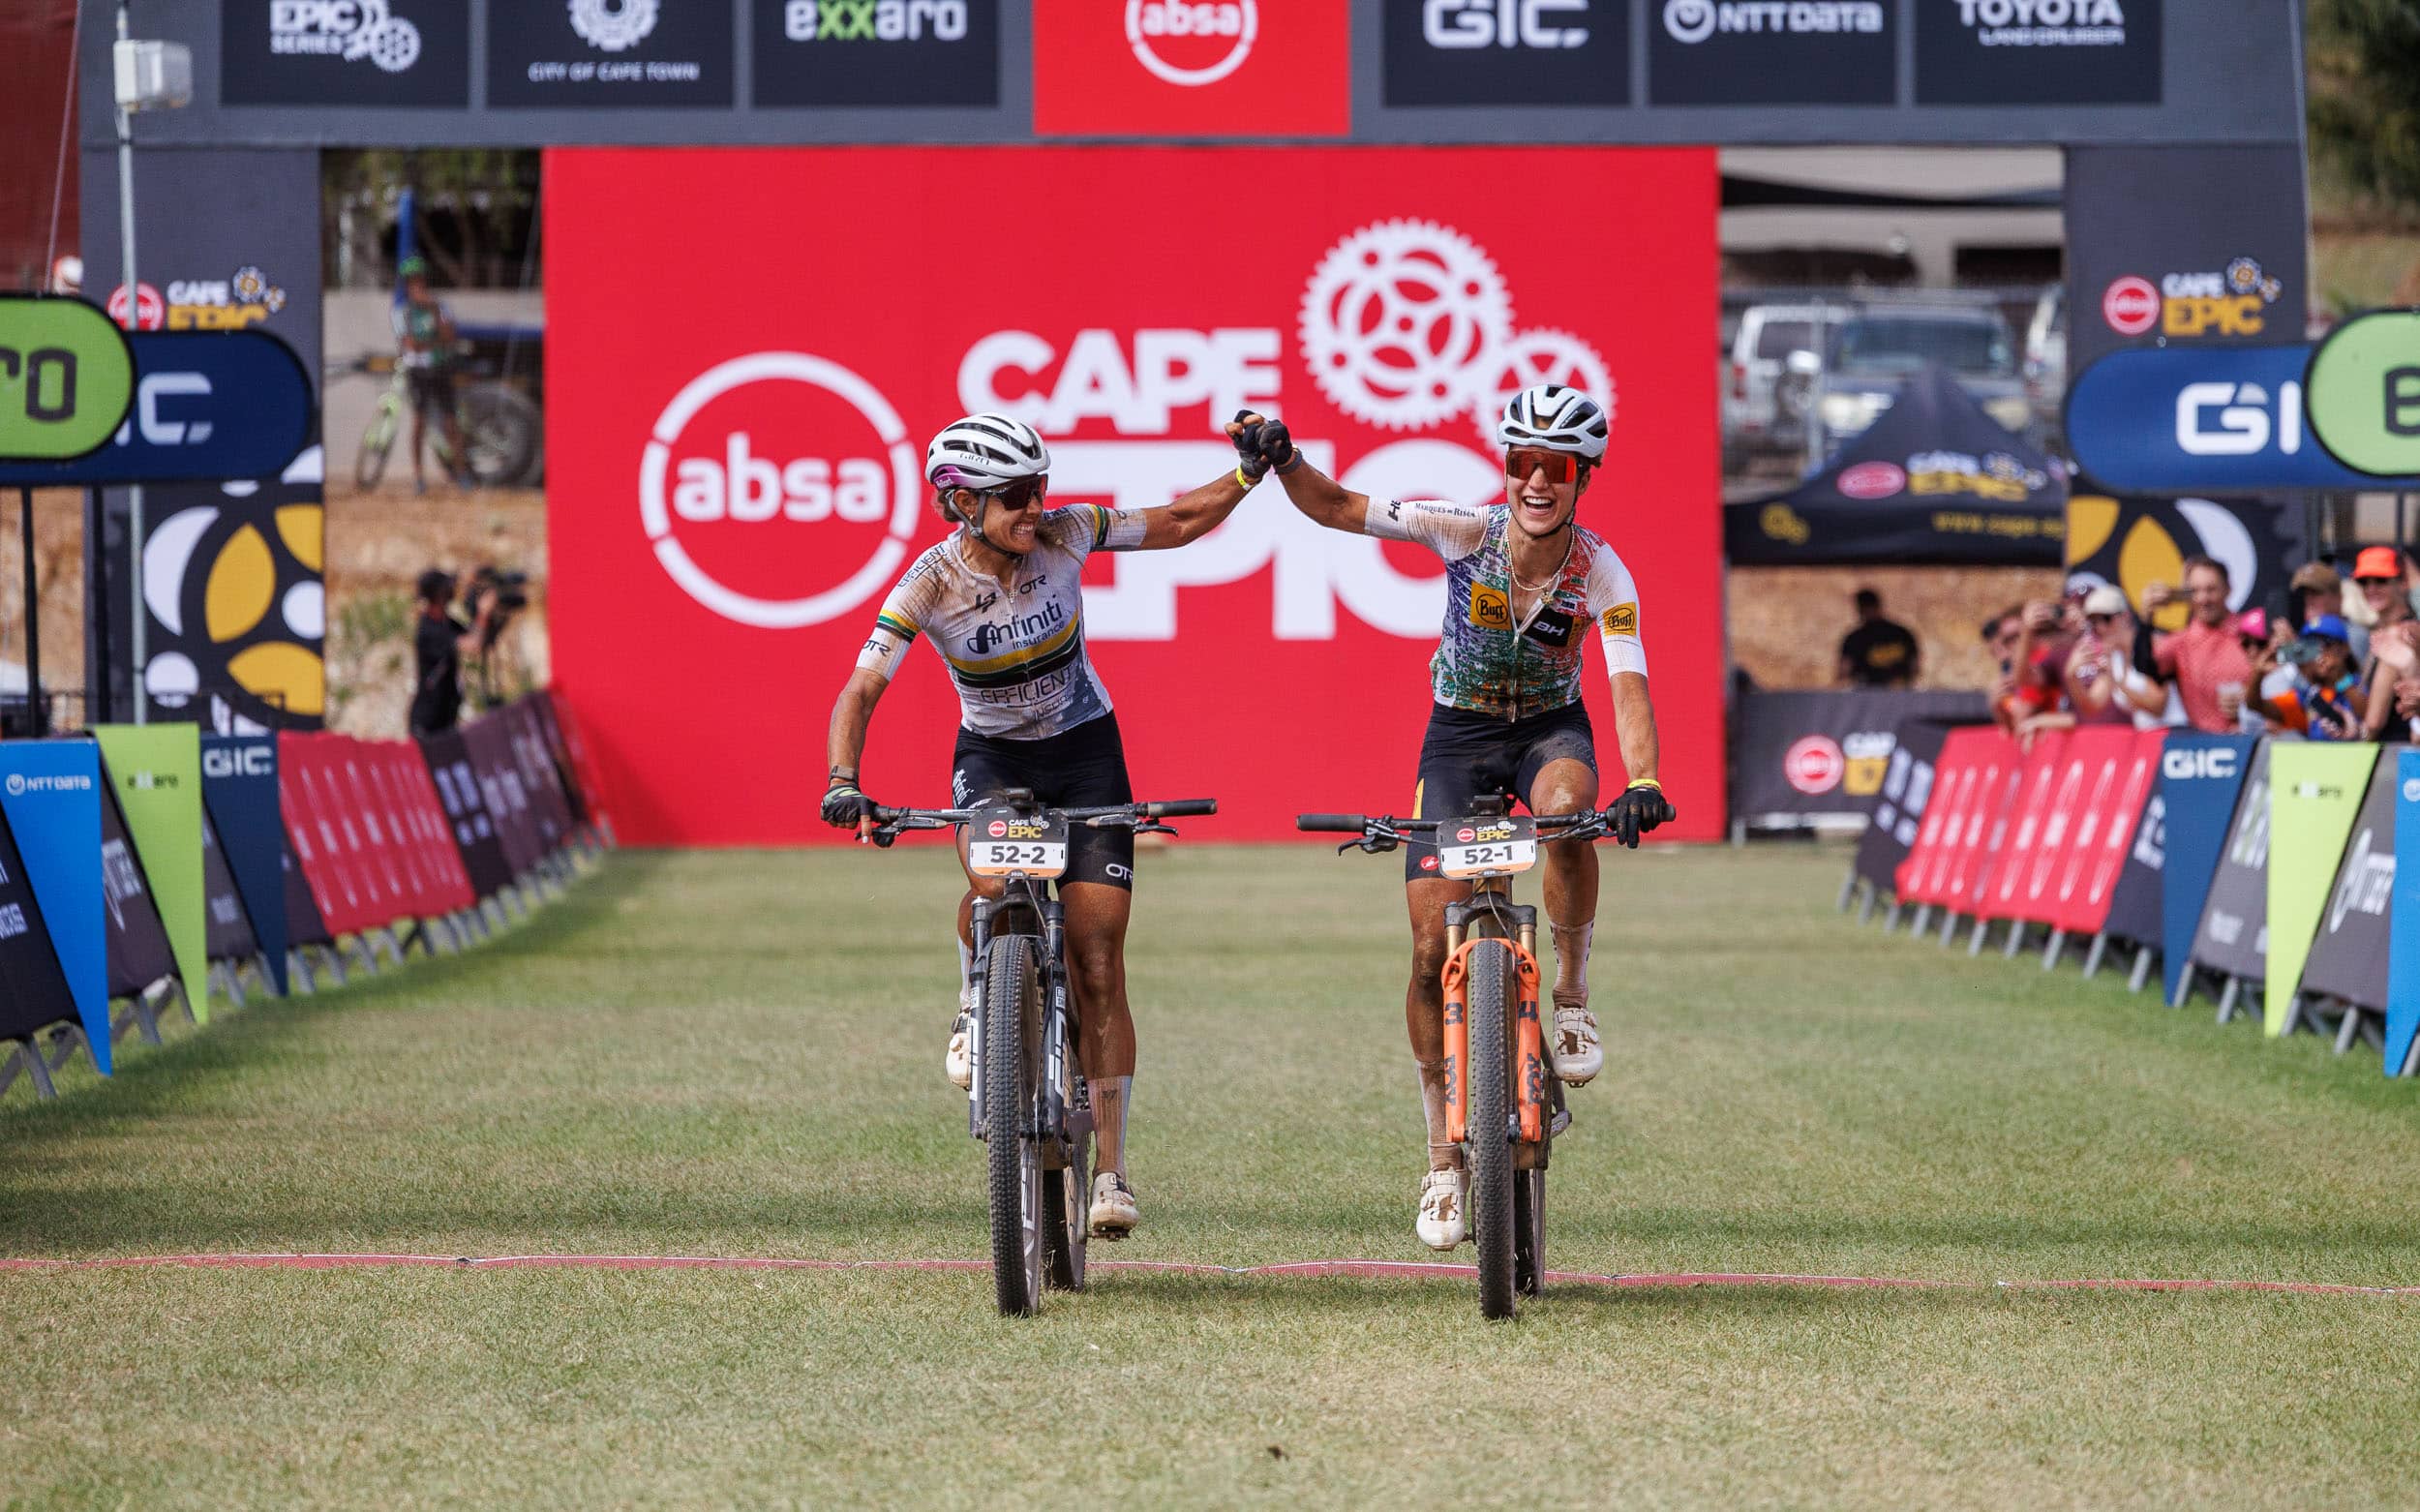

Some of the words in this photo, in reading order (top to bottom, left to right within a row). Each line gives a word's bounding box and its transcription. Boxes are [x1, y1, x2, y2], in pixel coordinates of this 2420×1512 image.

[270, 0, 362, 33] EPIC
[785, 0, 968, 41] exxaro
[1140, 0, 1241, 36] absa
[1422, 0, 1590, 48] GIC
[1955, 0, 2125, 27] TOYOTA
[528, 61, 567, 82] CITY
[568, 62, 596, 82] OF
[597, 61, 644, 82] CAPE
[646, 61, 701, 82] TOWN
[2161, 295, 2264, 336] EPIC
[956, 329, 1282, 436] CAPE
[673, 431, 889, 524] absa
[1019, 574, 1047, 595] OTR
[1013, 620, 1065, 650] insurance
[1532, 621, 1564, 637] BH
[980, 665, 1073, 705] EFFICIENT
[202, 746, 273, 778] GIC
[2163, 747, 2237, 779] GIC
[1008, 826, 1043, 838] EPIC
[1476, 830, 1511, 842] EPIC
[990, 845, 1045, 864] 52-2
[1464, 845, 1513, 864] 52-1
